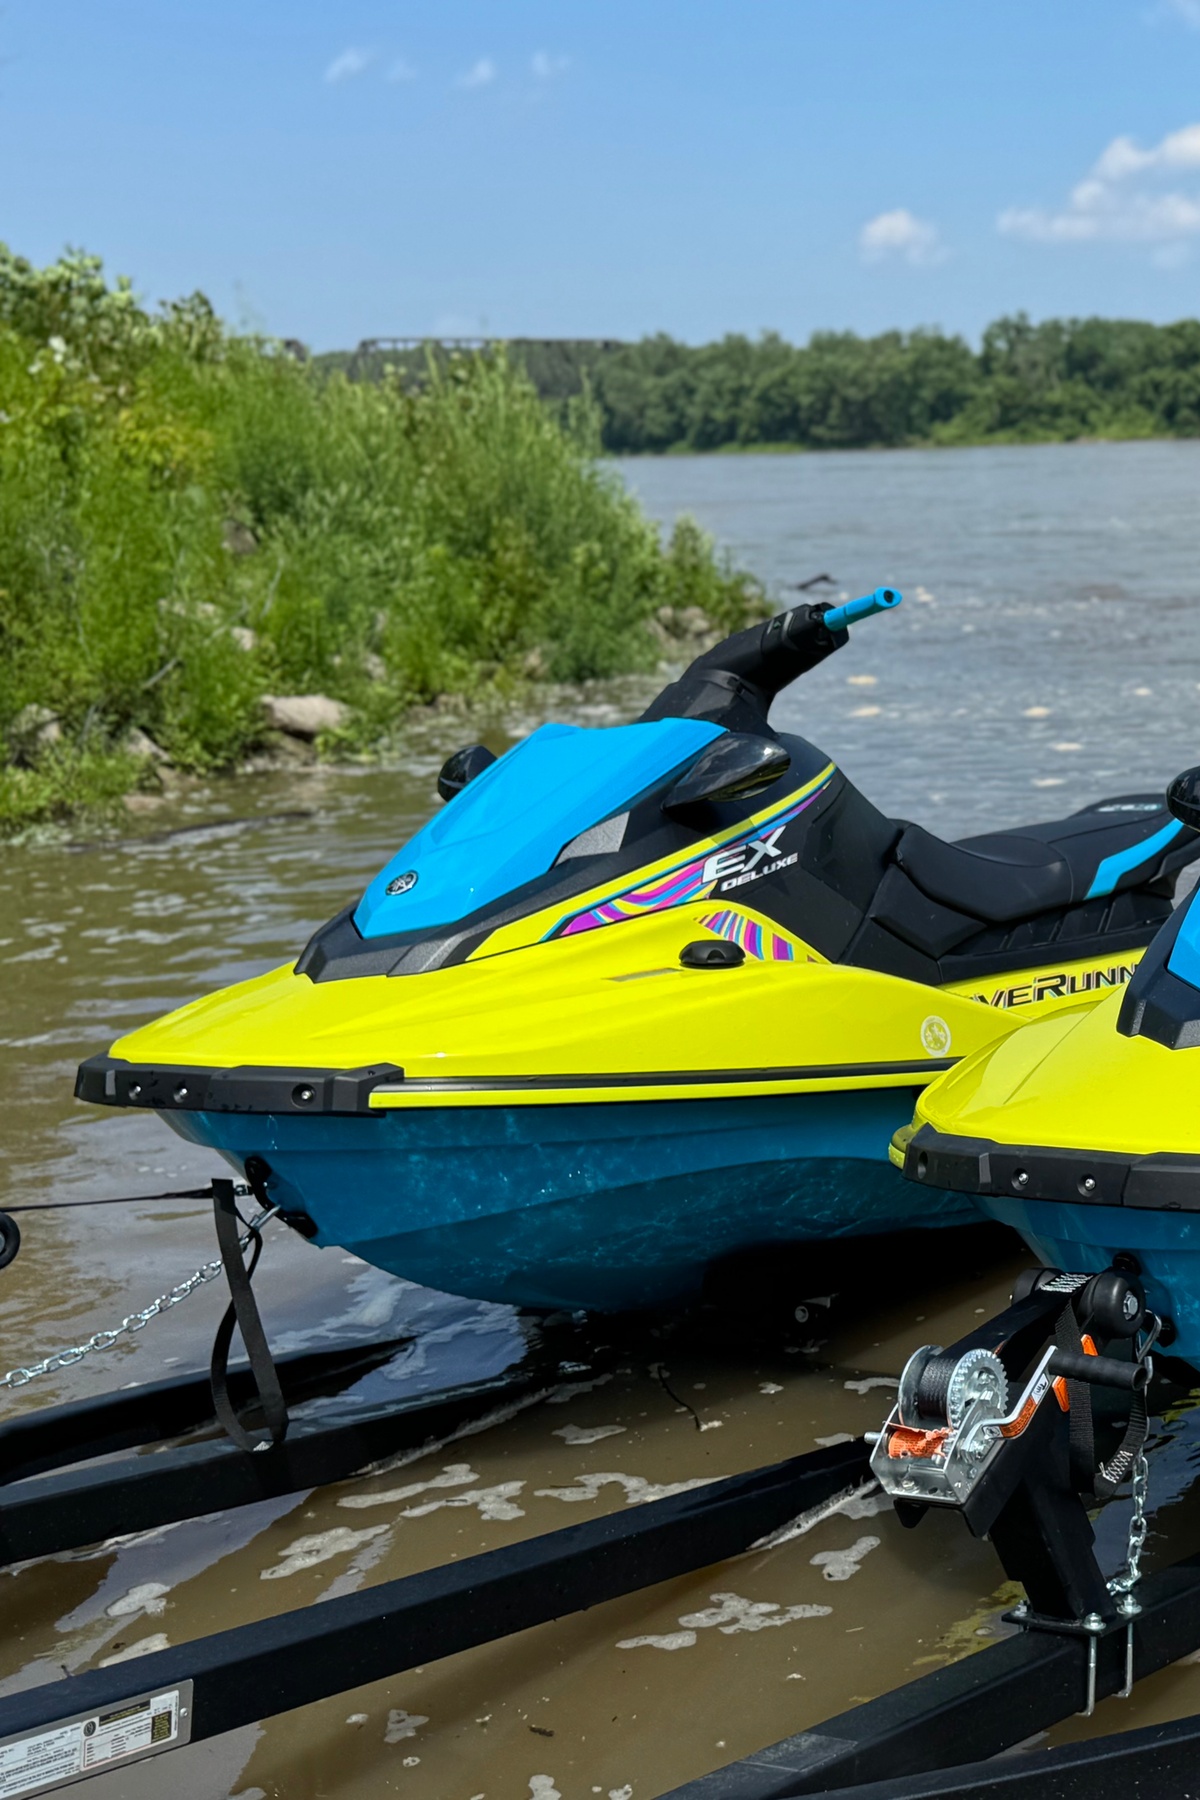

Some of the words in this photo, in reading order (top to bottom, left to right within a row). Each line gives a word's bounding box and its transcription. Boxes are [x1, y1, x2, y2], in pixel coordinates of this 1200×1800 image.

[702, 825, 786, 883] EX
[721, 853, 798, 891] DELUXE
[970, 963, 1139, 1008] VERUNN
